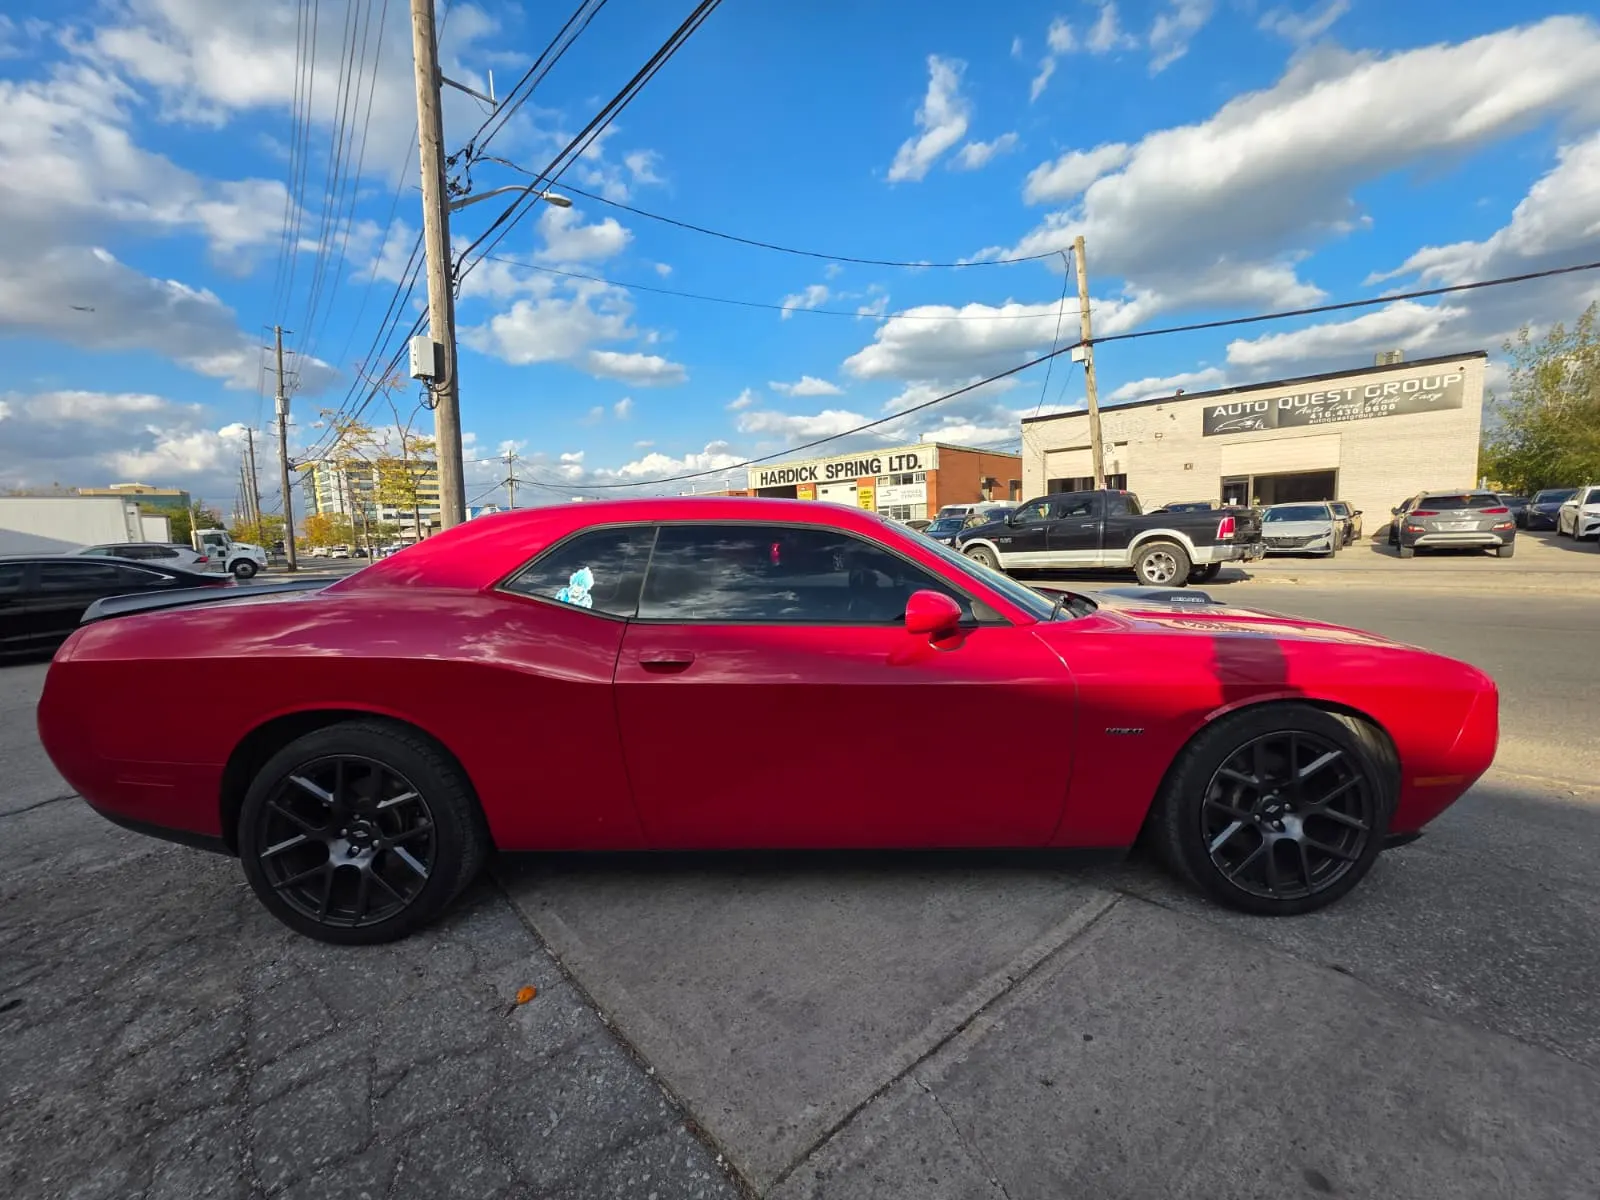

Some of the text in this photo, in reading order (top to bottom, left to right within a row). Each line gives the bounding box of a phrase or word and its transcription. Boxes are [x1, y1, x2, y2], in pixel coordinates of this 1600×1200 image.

[1212, 374, 1462, 417] AUTO QUEST GROUP
[760, 453, 922, 486] HARDICK SPRING LTD.
